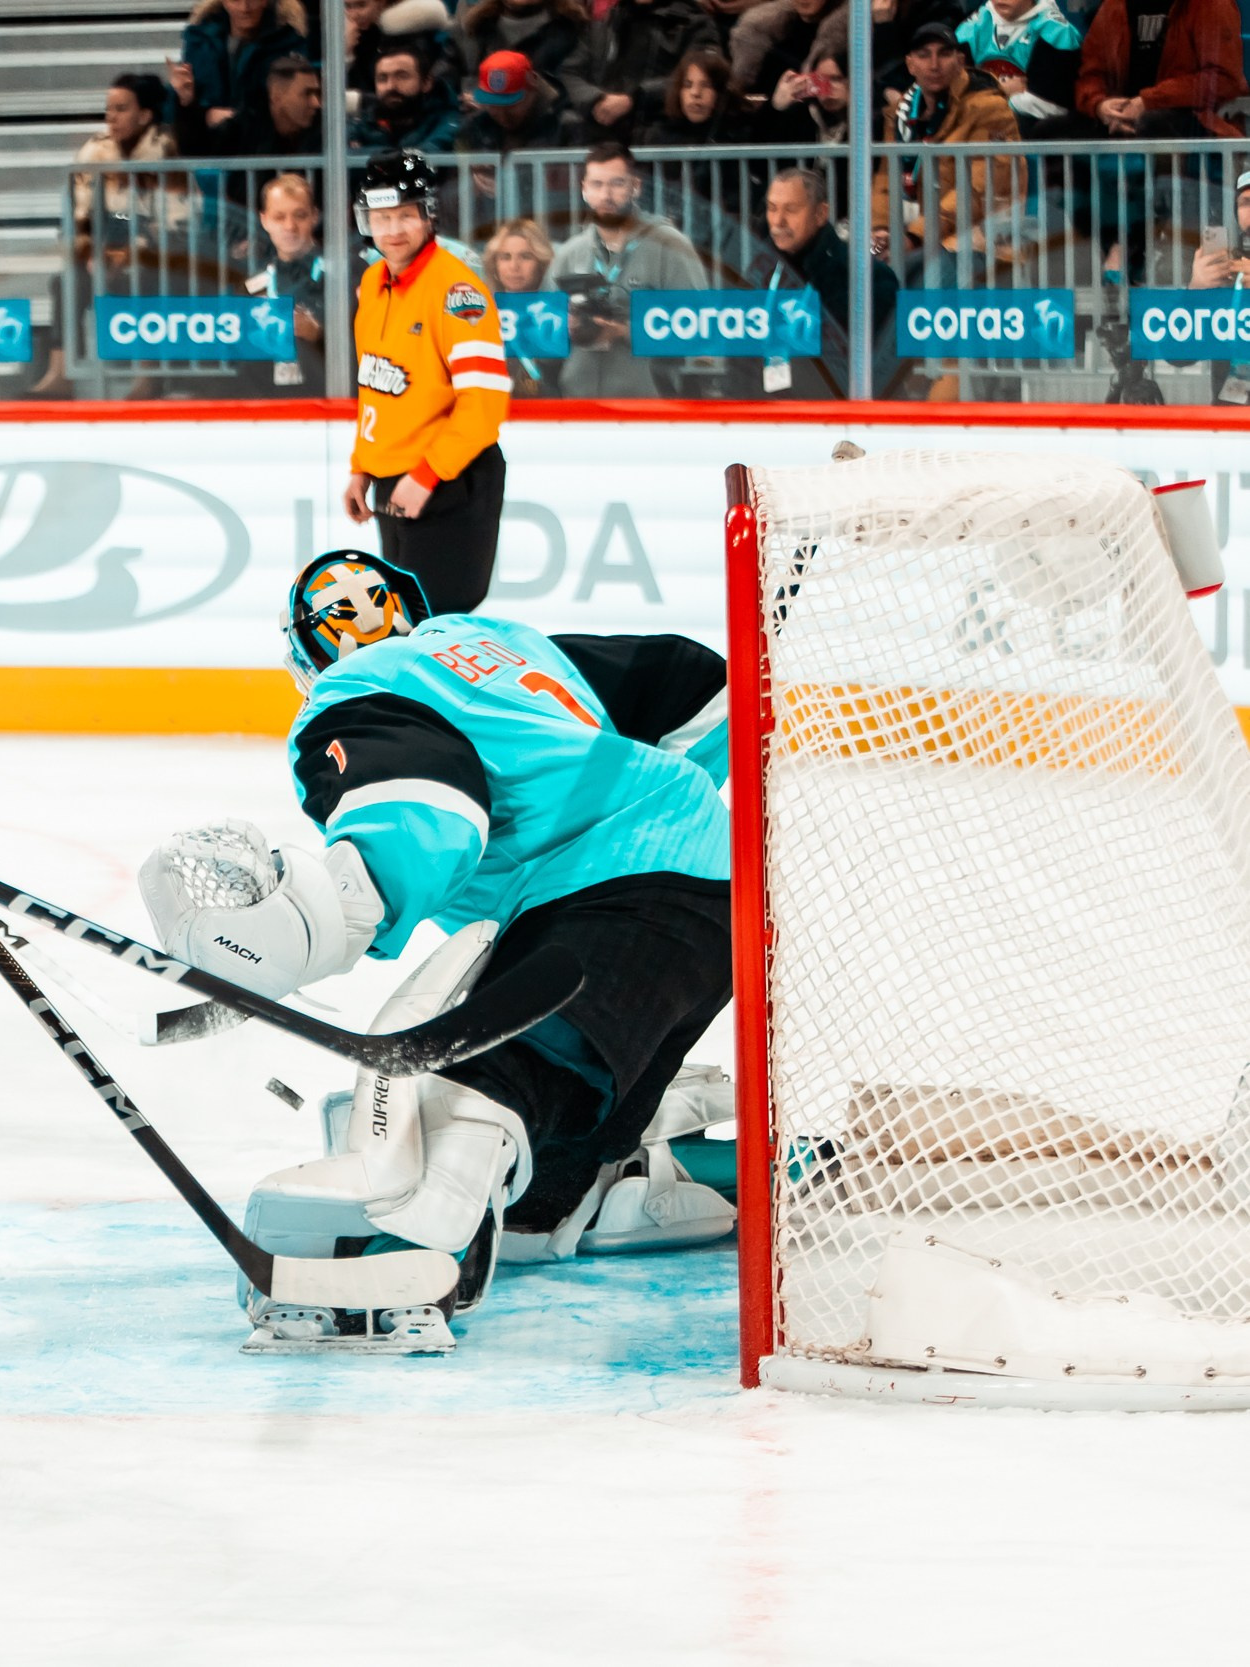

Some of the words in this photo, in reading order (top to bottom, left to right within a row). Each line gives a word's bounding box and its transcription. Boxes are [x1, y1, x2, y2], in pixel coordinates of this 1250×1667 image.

[109, 312, 241, 344] согаз
[643, 307, 769, 340] согаз
[907, 306, 1025, 341] согаз
[295, 499, 663, 604] LDA
[516, 669, 602, 730] 1
[325, 739, 347, 775] 1
[7, 893, 192, 983] CCM
[213, 935, 263, 965] MACH
[28, 997, 151, 1132] CCM
[372, 1074, 391, 1141] SUPRE
